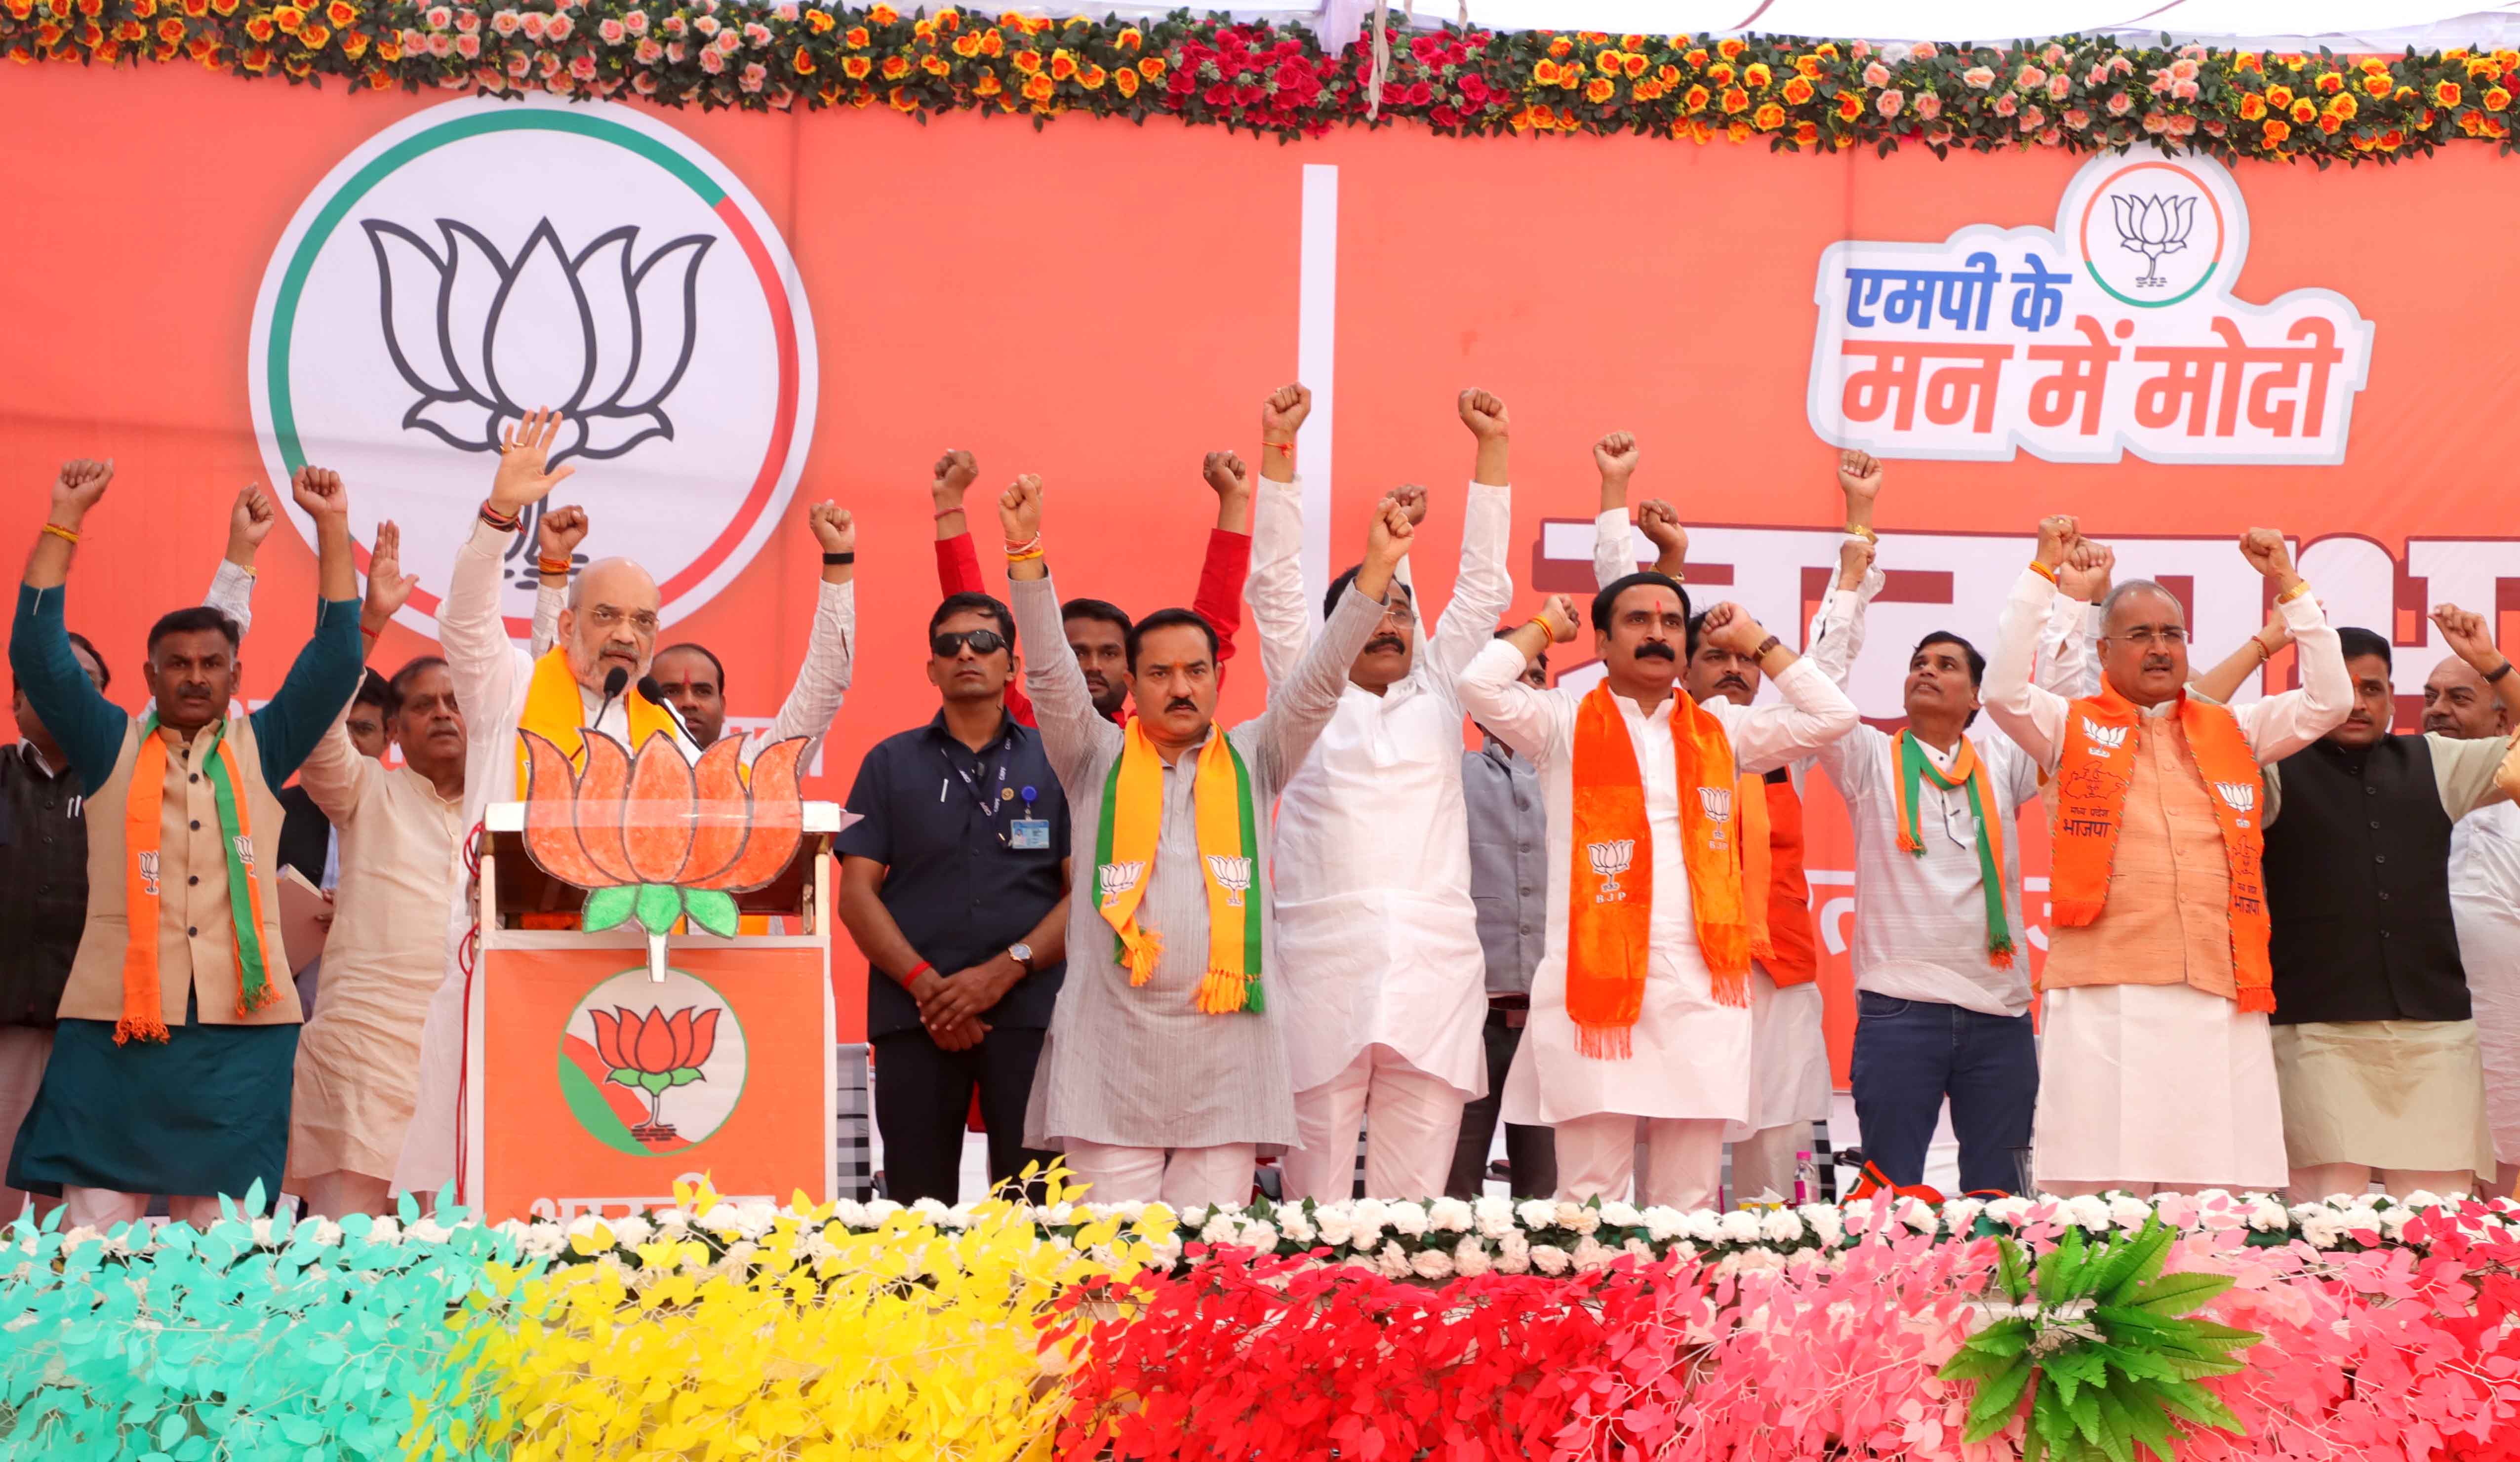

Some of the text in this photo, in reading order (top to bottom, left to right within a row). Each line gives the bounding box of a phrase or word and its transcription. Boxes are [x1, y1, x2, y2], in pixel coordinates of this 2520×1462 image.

[1844, 252, 2072, 332] एमपी के
[1841, 315, 2344, 437] मन में मोदी
[2063, 819, 2112, 837] भाजपा
[1596, 892, 1627, 904] BJP
